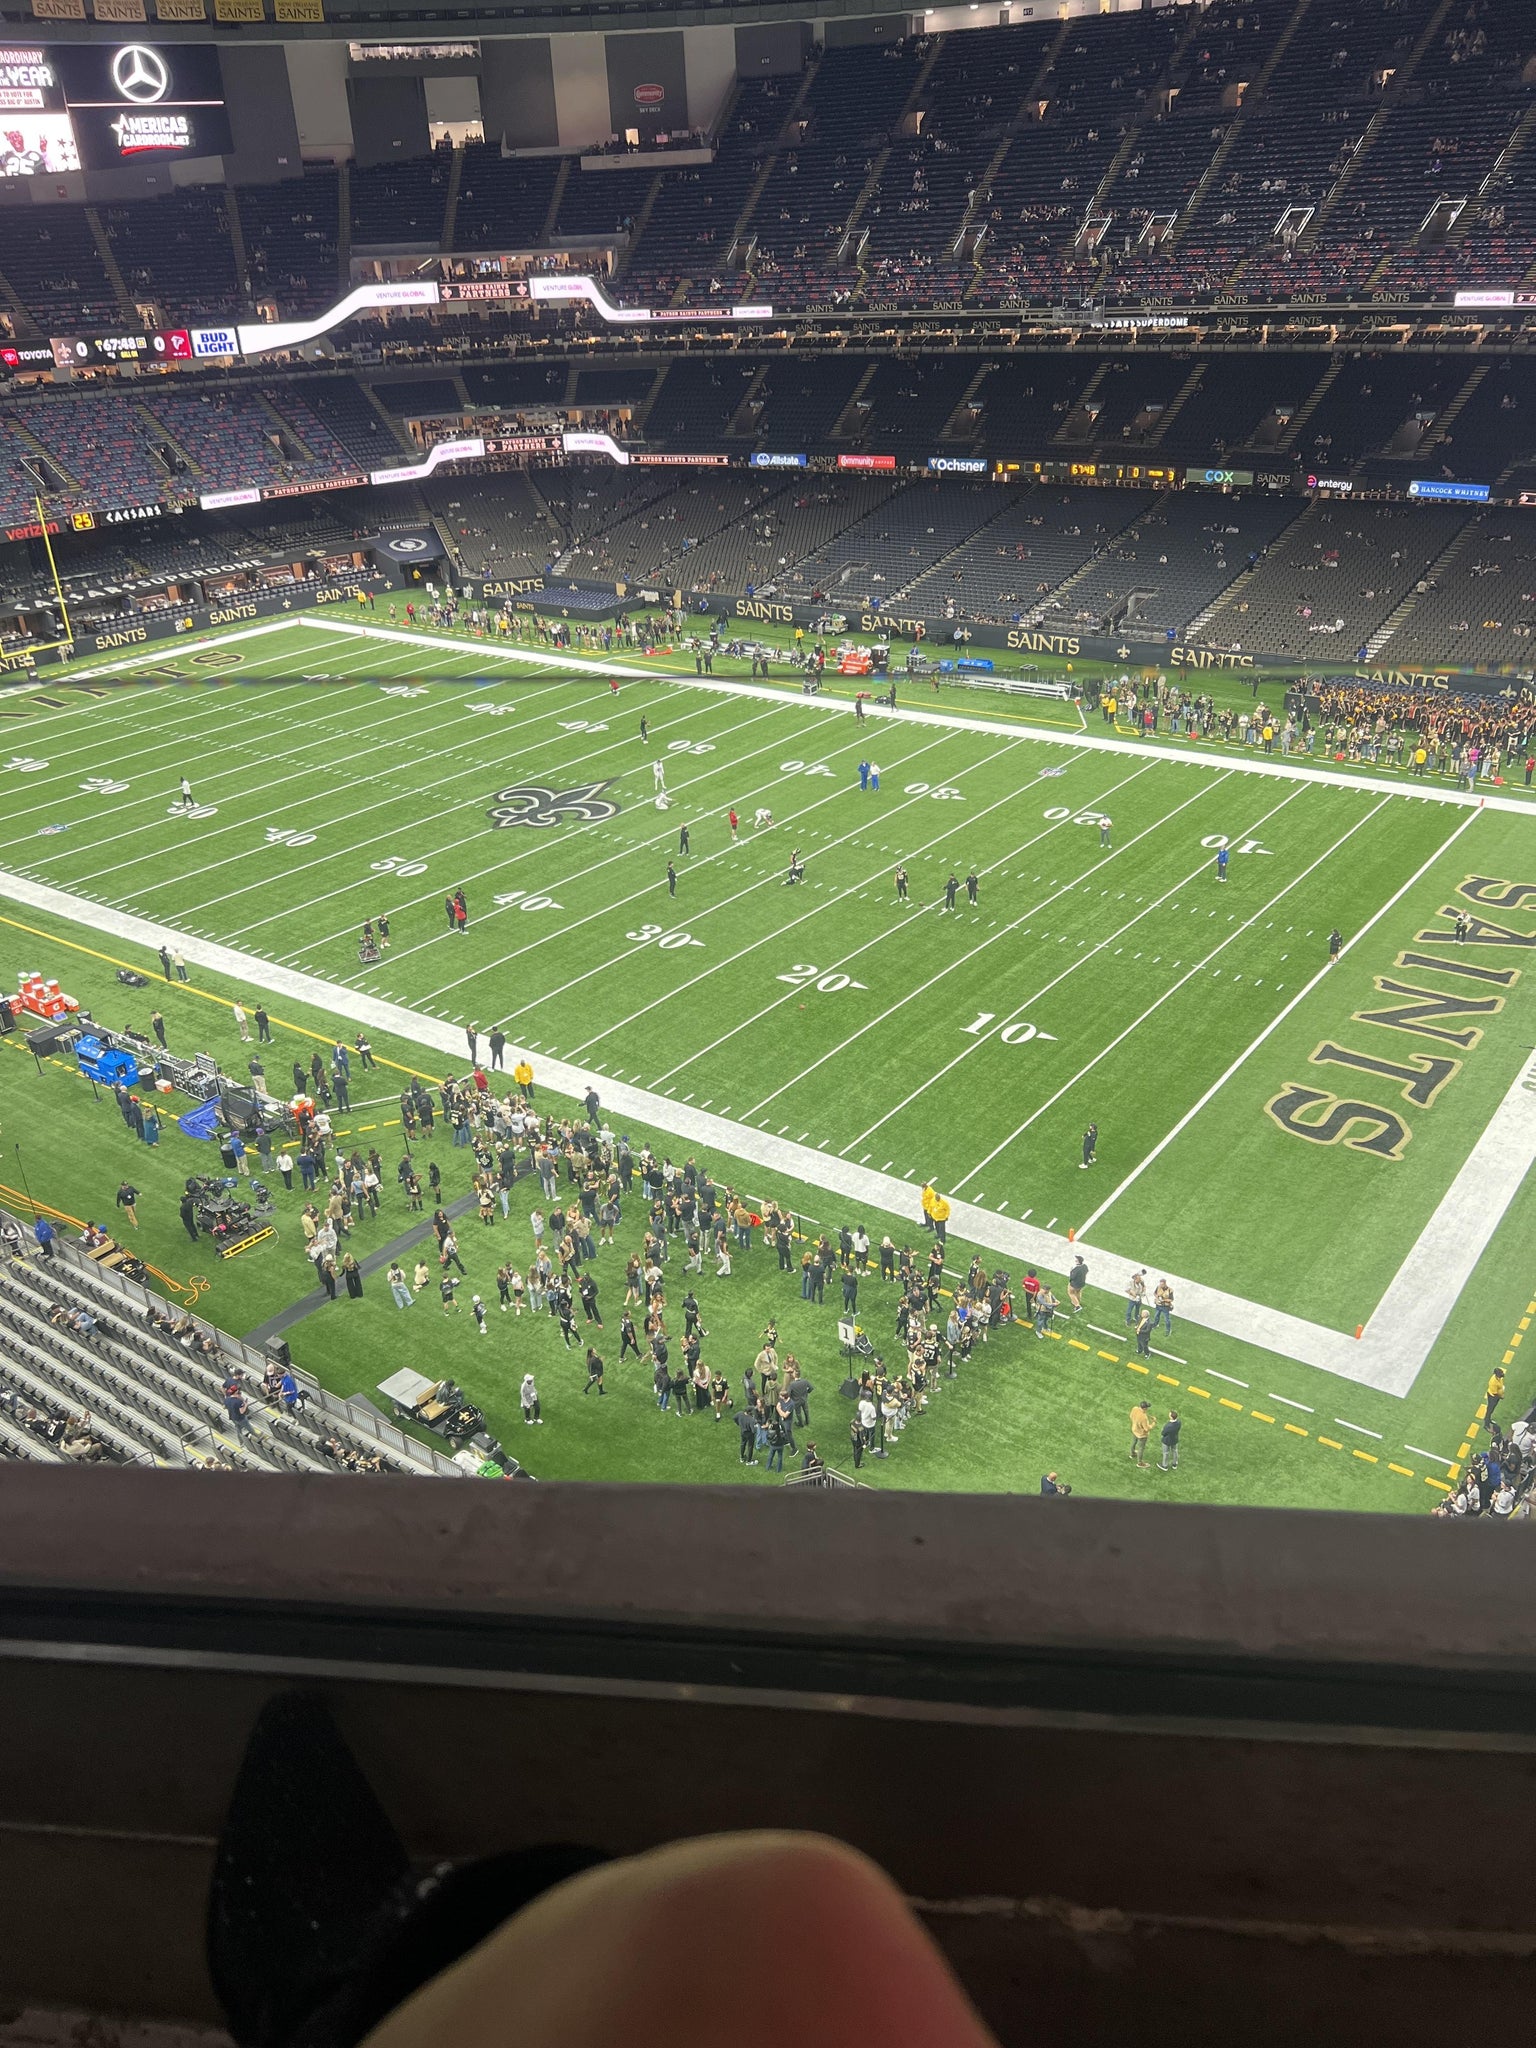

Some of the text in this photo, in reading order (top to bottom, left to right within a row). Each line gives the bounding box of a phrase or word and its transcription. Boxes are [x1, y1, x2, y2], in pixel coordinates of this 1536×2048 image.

[37, 3, 80, 16] SAINTS
[99, 7, 142, 18] SAINTS
[161, 6, 202, 17] SAINTS
[220, 8, 261, 18] SAINTS
[279, 8, 320, 19] SAINTS
[114, 114, 188, 135] AMERICAS
[542, 284, 567, 292] VENTURE
[459, 289, 511, 299] PARTNERS
[1290, 293, 1327, 304] SAINTS
[1371, 292, 1410, 303] SAINTS
[932, 301, 963, 311] SAINTS
[1000, 300, 1030, 310] SAINTS
[1140, 297, 1174, 307] SAINTS
[1213, 295, 1249, 306] SAINTS
[805, 304, 834, 313] SAINTS
[868, 303, 898, 312] SAINTS
[1136, 317, 1189, 328] SUPERDOME
[1216, 316, 1249, 326] SAINTS
[1288, 315, 1322, 325] SAINTS
[1362, 314, 1398, 325] SAINTS
[1441, 315, 1478, 325] SAINTS
[682, 326, 708, 335] SAINTS
[738, 325, 763, 334] SAINTS
[795, 323, 822, 332] SAINTS
[853, 322, 880, 331] SAINTS
[912, 321, 940, 330] SAINTS
[972, 321, 1001, 330] SAINTS
[200, 332, 228, 344] BUD
[504, 332, 532, 342] SAINTS
[565, 329, 593, 339] SAINTS
[624, 328, 650, 337] SAINTS
[443, 335, 470, 346] SAINTS
[197, 342, 235, 354] LIGHT
[18, 349, 53, 361] TOYOTA
[502, 442, 547, 452] PARTNERS
[770, 455, 799, 466] Allstate
[809, 456, 836, 465] SAINTS
[840, 455, 875, 467] Community
[937, 458, 985, 473] Ochsner
[1205, 470, 1234, 483] COX
[1257, 473, 1291, 484] SAINTS
[1318, 479, 1353, 491] entergy
[1420, 486, 1490, 498] HANCOCK WHITNEY
[167, 498, 198, 510] SAINTS
[209, 496, 233, 505] VENTURE
[106, 505, 163, 523] CAESARS
[74, 514, 92, 529] 25
[6, 521, 60, 542] verizon
[137, 559, 266, 588] SUPERDOME
[483, 577, 544, 599] SAINTS
[516, 602, 535, 612] SAINTS
[736, 599, 794, 622] SAINTS
[209, 603, 257, 626] SAINTS
[96, 627, 148, 651] SAINTS
[1007, 630, 1081, 656] SAINTS
[1170, 647, 1256, 669] SAINTS
[667, 739, 717, 755] 50
[779, 760, 833, 777] 40
[79, 777, 131, 795] 20
[903, 782, 960, 800] 30
[264, 826, 318, 848] 40
[370, 855, 429, 877] 50
[493, 889, 553, 912] 40
[626, 923, 692, 950] 30
[775, 963, 851, 993] 20
[1263, 873, 1536, 1161] SAINTS
[959, 1011, 1038, 1045] 10
[843, 1327, 850, 1341] 1
